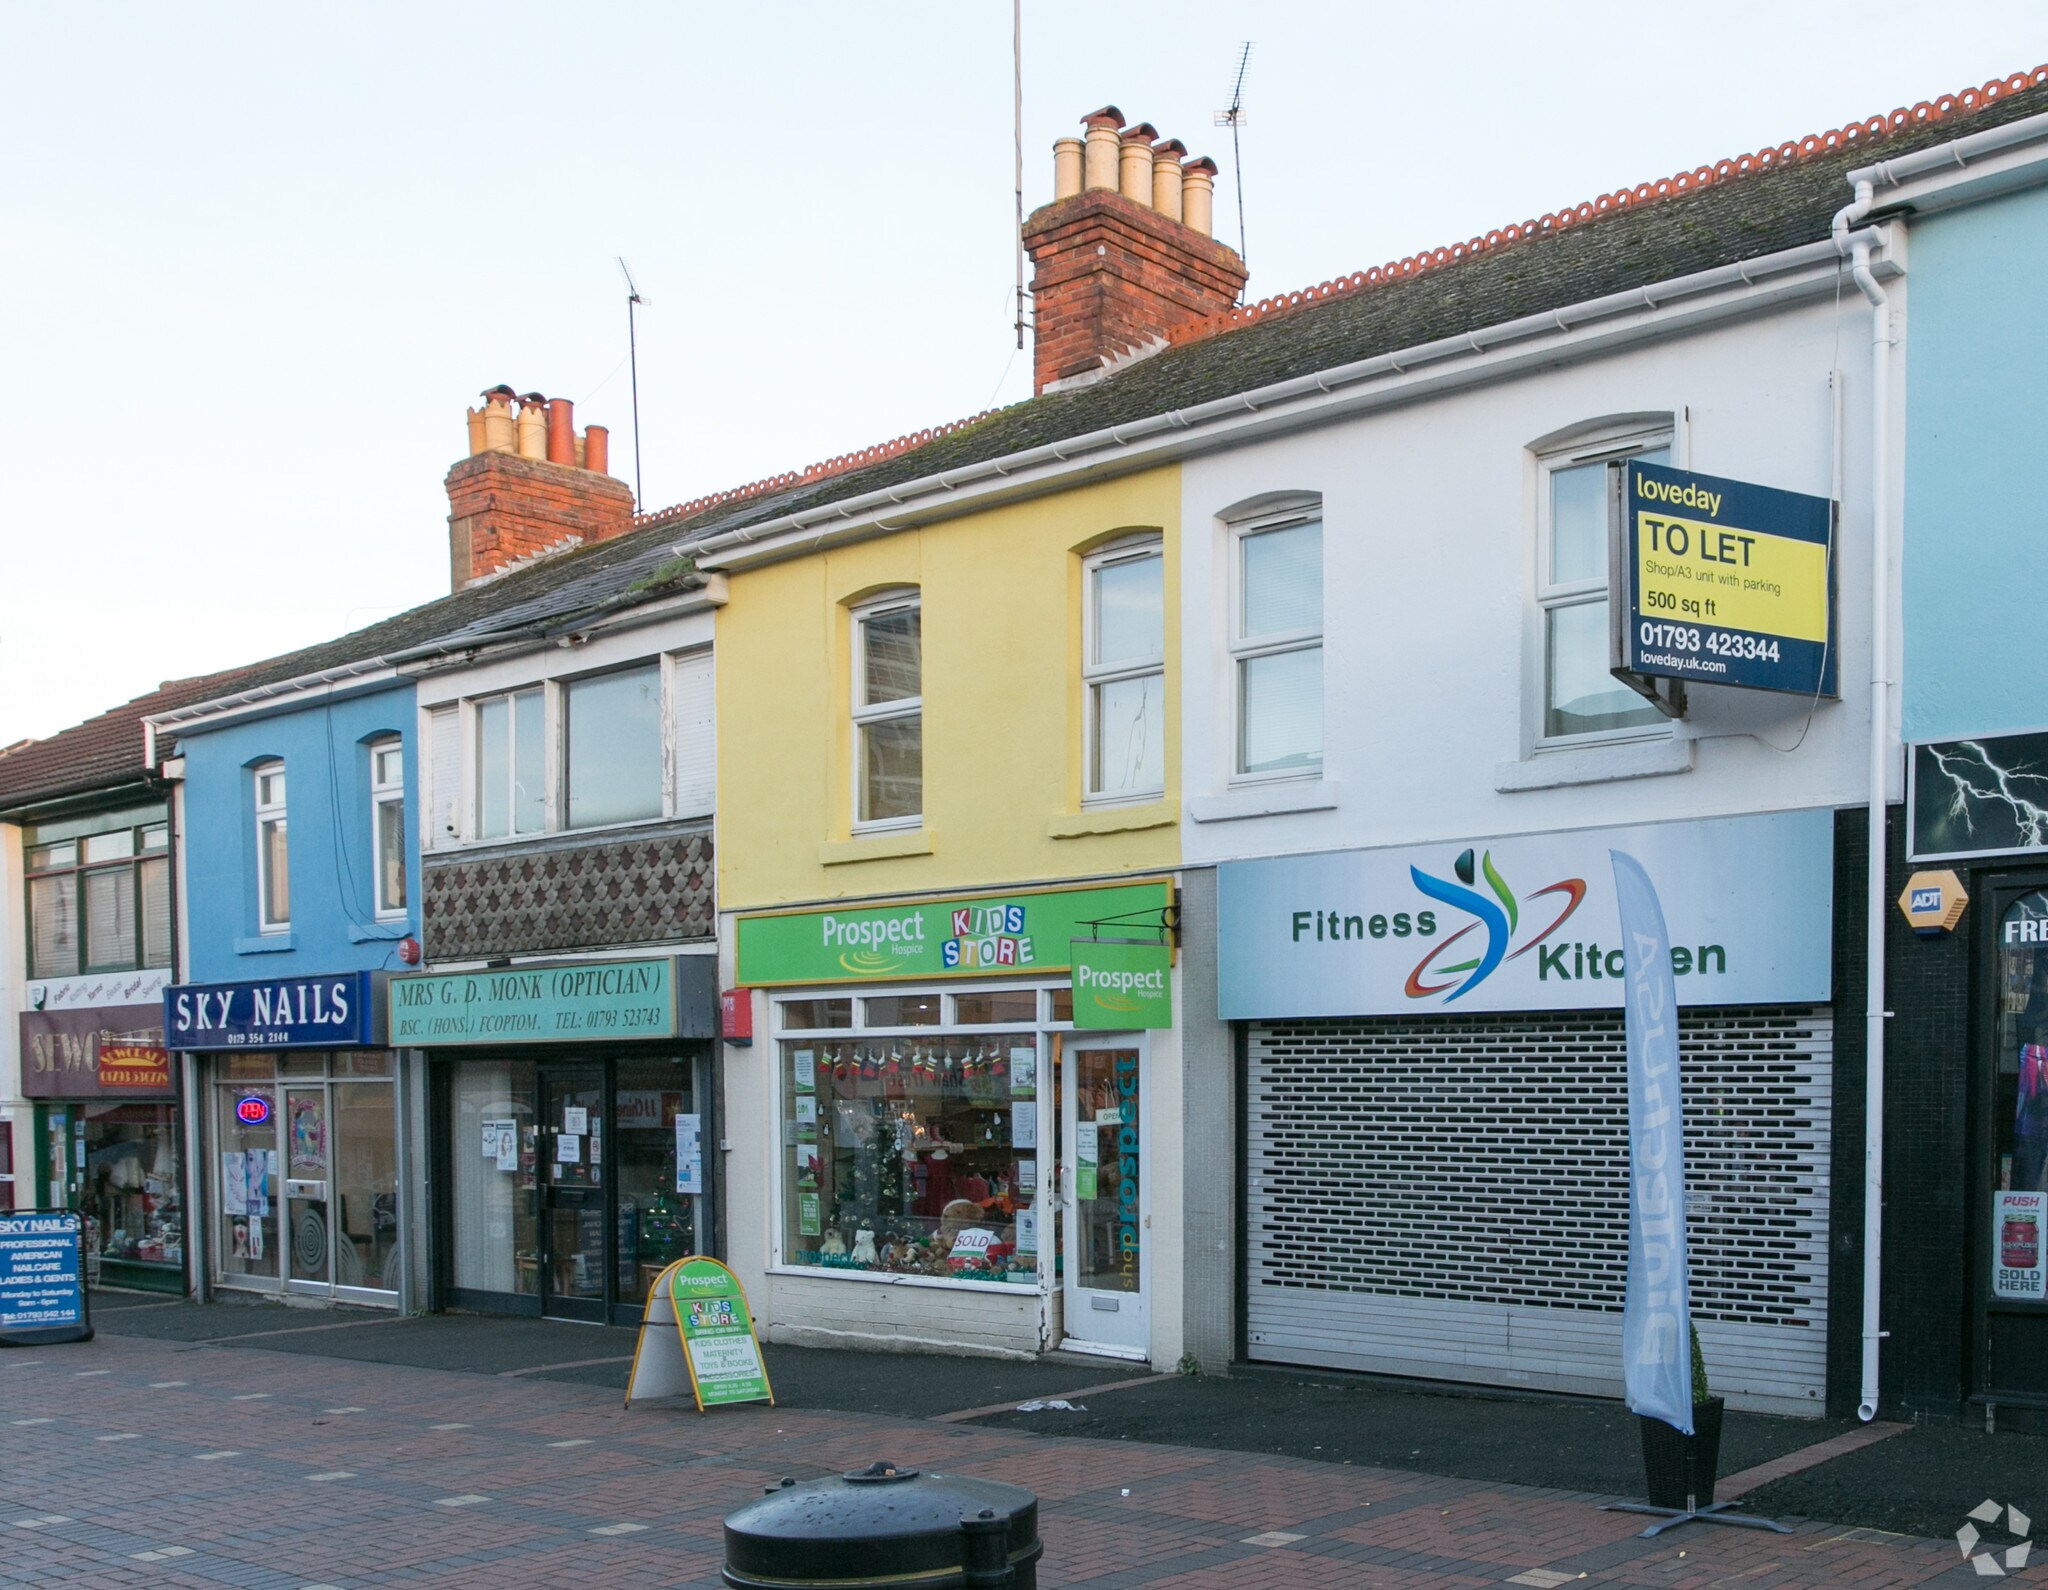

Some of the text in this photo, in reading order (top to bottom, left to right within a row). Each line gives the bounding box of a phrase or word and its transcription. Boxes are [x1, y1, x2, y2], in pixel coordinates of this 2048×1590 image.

[1637, 472, 1721, 517] loveday
[1645, 519, 1755, 566] TO LET
[1646, 559, 1781, 597] Shop/A3 unit with parking
[1647, 590, 1716, 618] 500 sq ft
[1640, 622, 1780, 662] 01793 423344
[1641, 650, 1726, 673] loveday.uk.com
[1912, 891, 1941, 909] ADT
[951, 905, 1025, 936] KIDS
[1292, 909, 1437, 942] Fitness
[823, 912, 925, 952] Prospect
[891, 943, 924, 957] Hospice
[943, 937, 1034, 967] STORE
[1538, 943, 1726, 981] Kitcen
[399, 963, 661, 1007] MRS G. D. MONK (OPTICIAN)
[1079, 965, 1164, 994] Prospect
[1137, 988, 1164, 999] Hospice
[177, 983, 348, 1032] SKY NAILS
[400, 1019, 424, 1036] BSC.
[428, 1016, 475, 1036] (HONS.)
[555, 1011, 582, 1030] TEL:
[587, 1009, 617, 1029] 01793
[622, 1007, 660, 1027] 523743
[227, 1032, 289, 1044] 0179 354 2144
[239, 1103, 265, 1118] OPEN
[1117, 1056, 1139, 1252] prospect
[2003, 1196, 2040, 1206] PUSH
[0, 1218, 76, 1232] SKY NAILS
[0, 1239, 73, 1249] PROFESSIONAL
[955, 1235, 989, 1247] SOLD
[10, 1251, 63, 1261] AMERICAN
[1122, 1232, 1137, 1289] shop
[13, 1263, 61, 1273] NAILCARE
[1999, 1269, 2041, 1280] SOLD
[0, 1273, 76, 1285] LADIES & GENTS
[680, 1274, 728, 1287] Prospect
[1999, 1281, 2040, 1292] HERE
[693, 1301, 731, 1313] KIDS
[690, 1313, 740, 1327] STORE
[714, 1337, 748, 1346] CLOTHES
